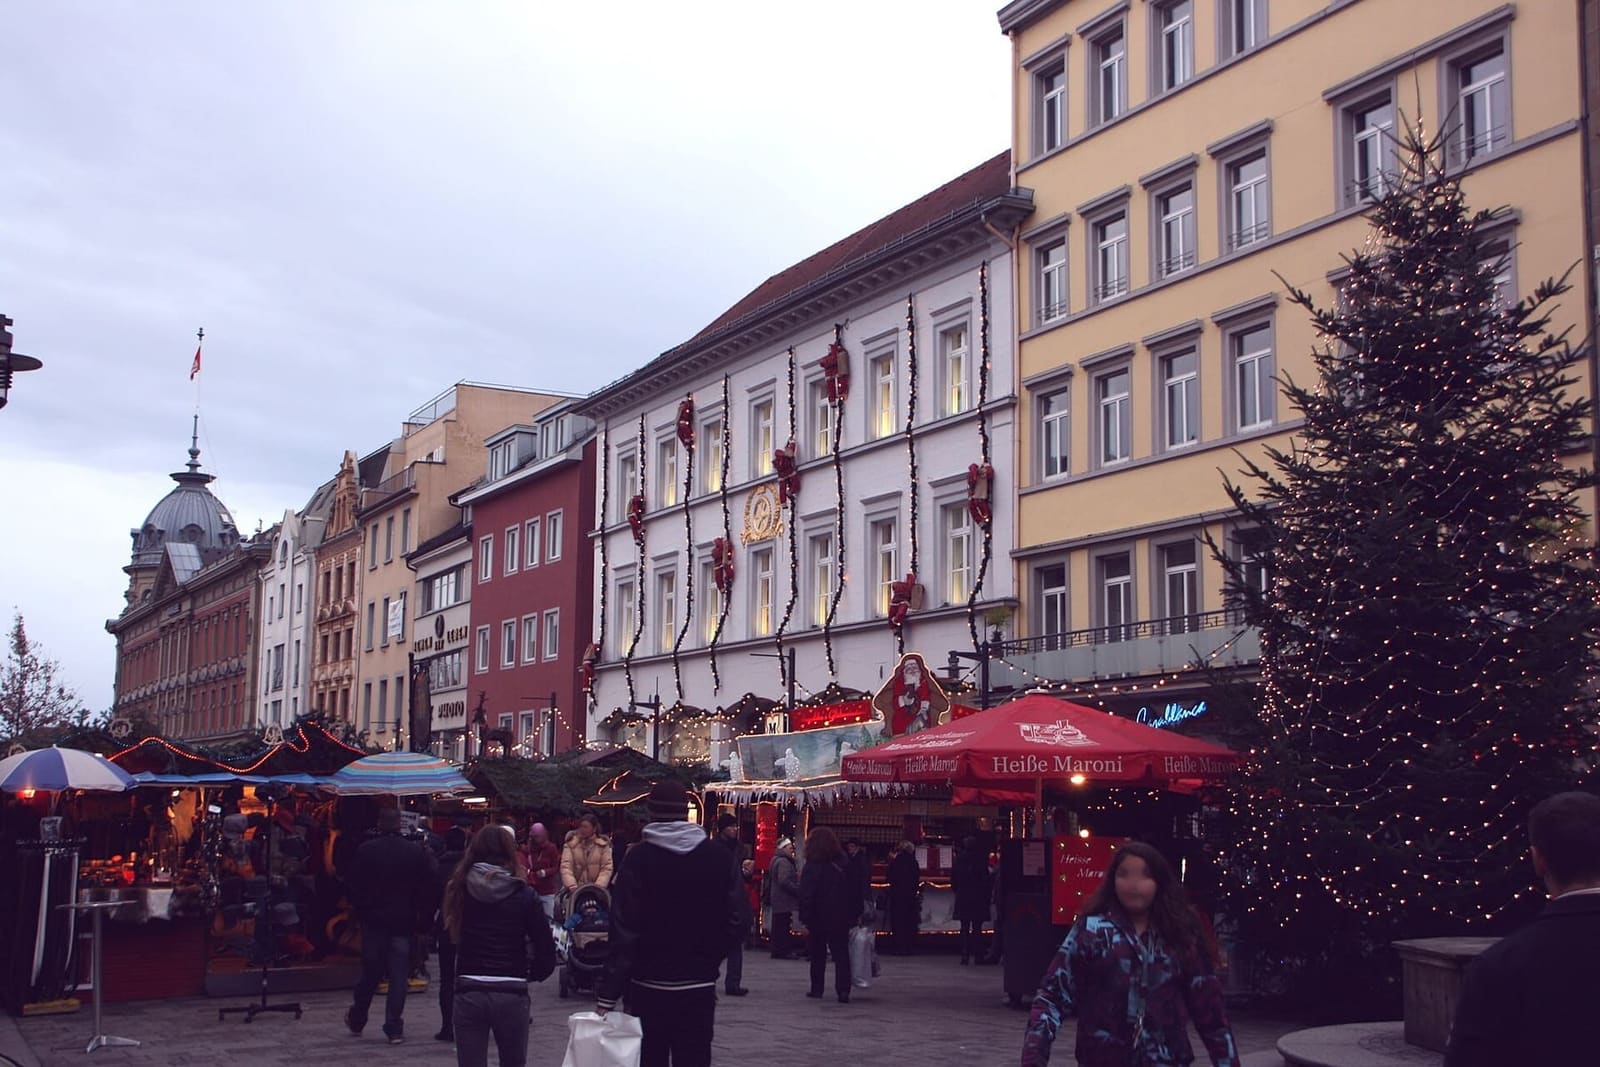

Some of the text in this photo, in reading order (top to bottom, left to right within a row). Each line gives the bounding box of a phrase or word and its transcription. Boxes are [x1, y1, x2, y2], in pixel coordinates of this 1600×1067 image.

[438, 701, 464, 718] PHOTO
[905, 754, 960, 774] Heiße Maroni
[992, 755, 1123, 773] Heiße Maroni
[1164, 755, 1198, 773] Heiße
[1060, 854, 1092, 864] Heisse
